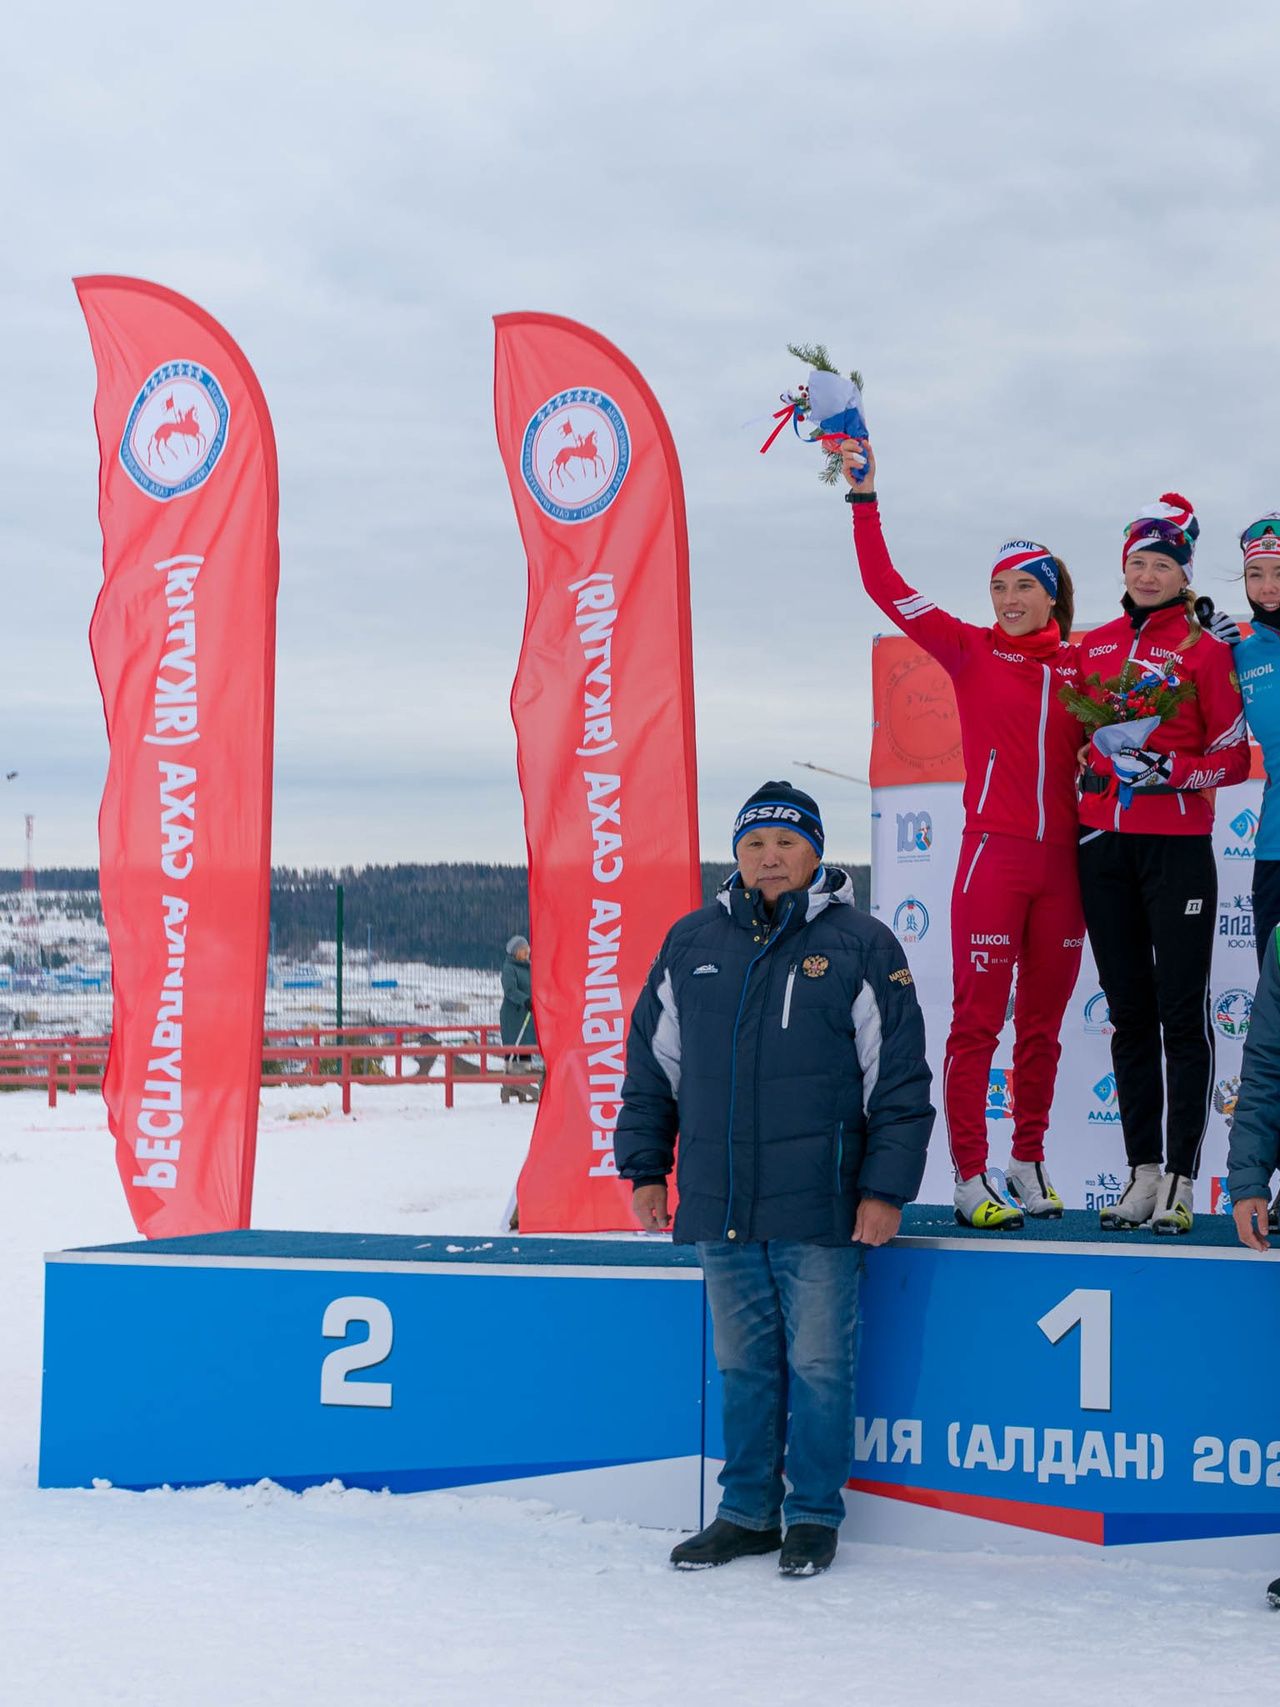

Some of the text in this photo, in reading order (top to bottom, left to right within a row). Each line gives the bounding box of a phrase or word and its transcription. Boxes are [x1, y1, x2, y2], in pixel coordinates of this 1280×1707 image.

[1239, 663, 1274, 682] LUKOIL
[734, 806, 801, 837] USSIA
[971, 933, 1010, 945] LUKOIL
[320, 1296, 393, 1408] 2
[1037, 1289, 1111, 1411] 1
[947, 1423, 1164, 1484] (АЛДАН)
